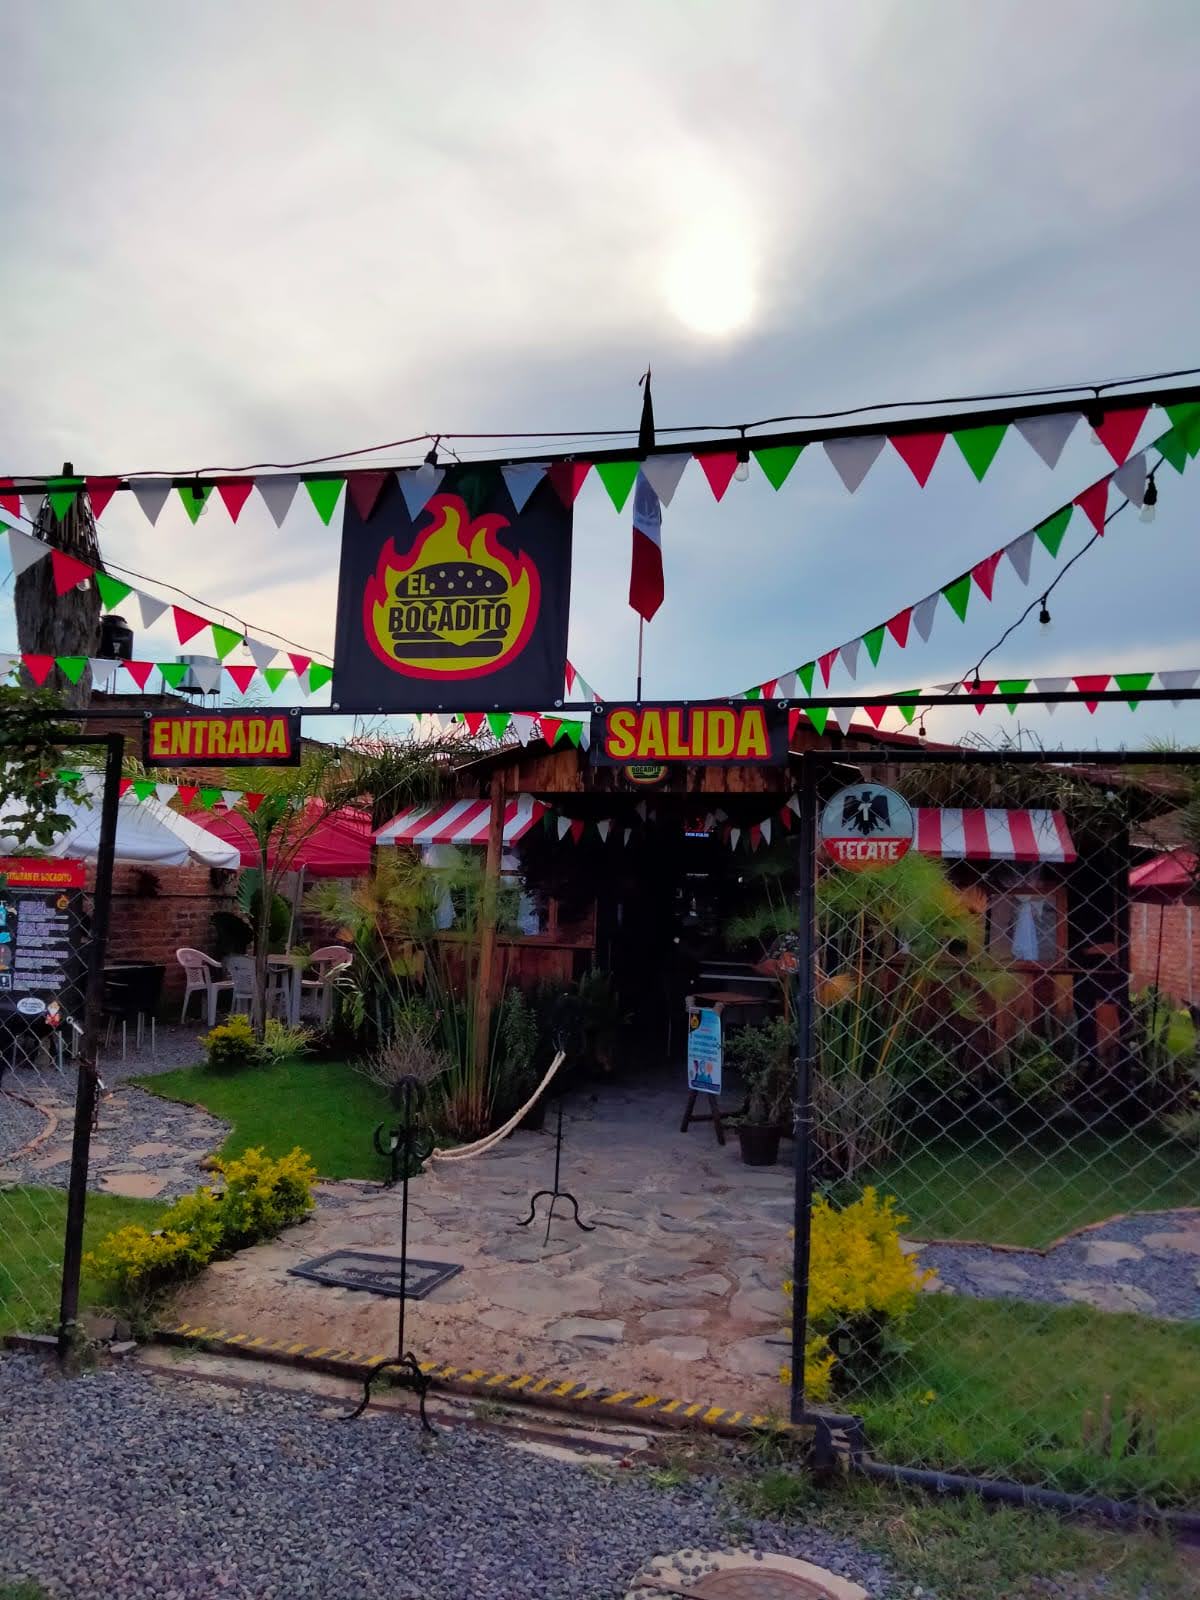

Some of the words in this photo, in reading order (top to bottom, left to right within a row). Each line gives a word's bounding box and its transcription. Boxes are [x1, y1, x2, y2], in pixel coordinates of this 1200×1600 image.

[407, 574, 430, 595] EL
[388, 604, 511, 633] BOCADITO
[152, 719, 288, 756] ENTRADA
[607, 708, 769, 758] SALIDA
[834, 841, 900, 860] TECATE
